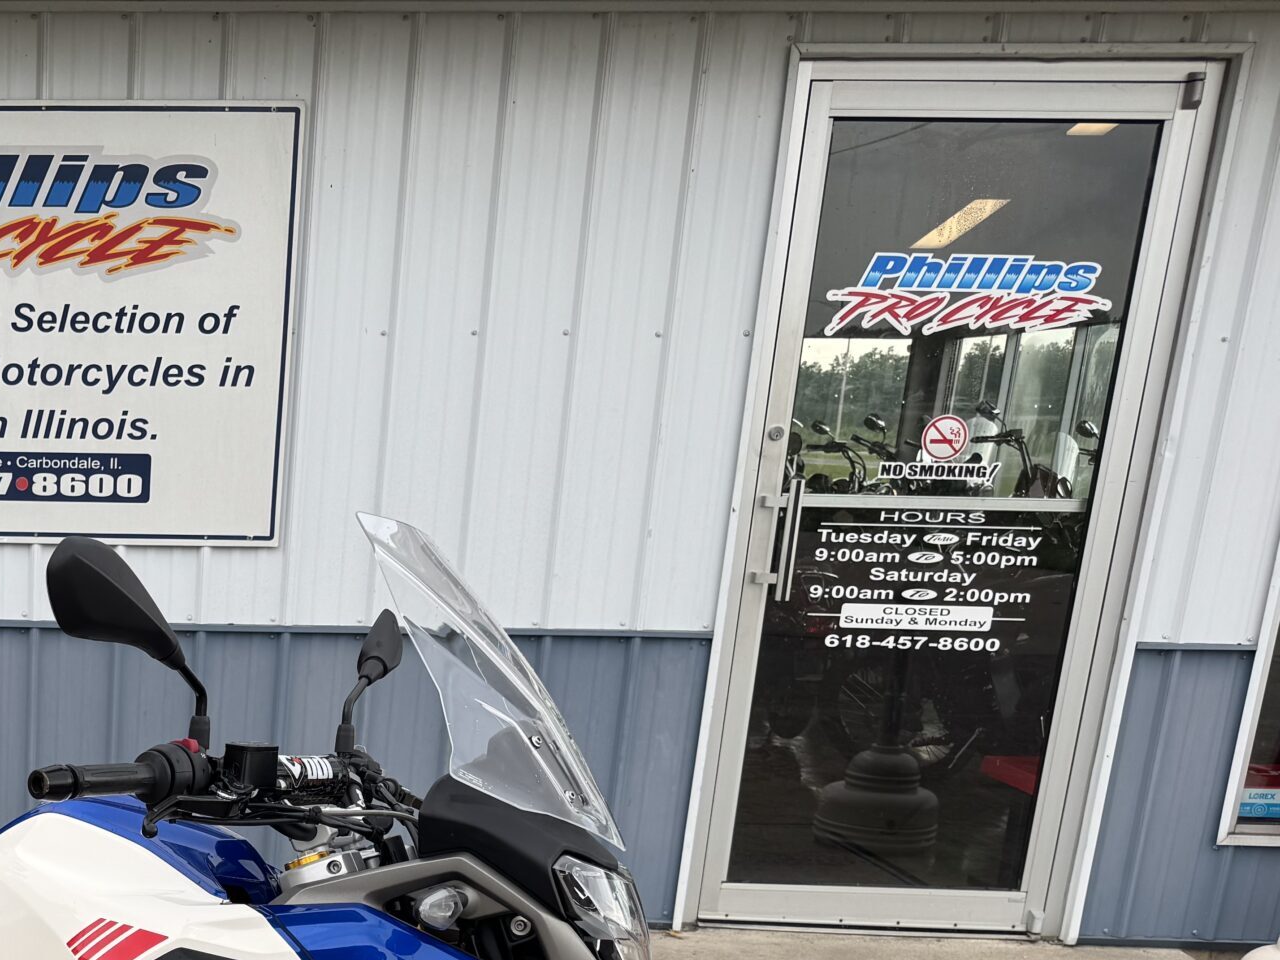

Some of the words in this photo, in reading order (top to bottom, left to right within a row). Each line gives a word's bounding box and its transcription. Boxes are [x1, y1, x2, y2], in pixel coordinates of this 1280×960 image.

[862, 255, 1099, 294] Phillips
[10, 303, 184, 335] Selection
[197, 305, 239, 335] of
[828, 289, 948, 334] PRO
[924, 292, 1111, 333] CYCLE
[218, 357, 256, 388] in
[19, 409, 160, 441] Illinois.
[15, 456, 106, 471] Carbondale,
[880, 463, 905, 477] NO
[907, 463, 1001, 483] SMOKING!
[880, 511, 986, 524] HOURS
[817, 529, 917, 547] Tuesday
[966, 533, 1043, 549] Friday
[815, 548, 900, 563] 9:00am
[950, 551, 1038, 568] 5:00pm
[869, 567, 977, 586] Saturday
[809, 585, 894, 599] 9:00am
[943, 588, 1031, 605] 2:00pm
[843, 615, 904, 627] Sunday
[907, 617, 920, 626] &
[924, 618, 987, 629] Monday
[882, 607, 951, 617] CLOSED
[824, 634, 1001, 652] 618-457-8600
[1248, 792, 1276, 800] LOREX
